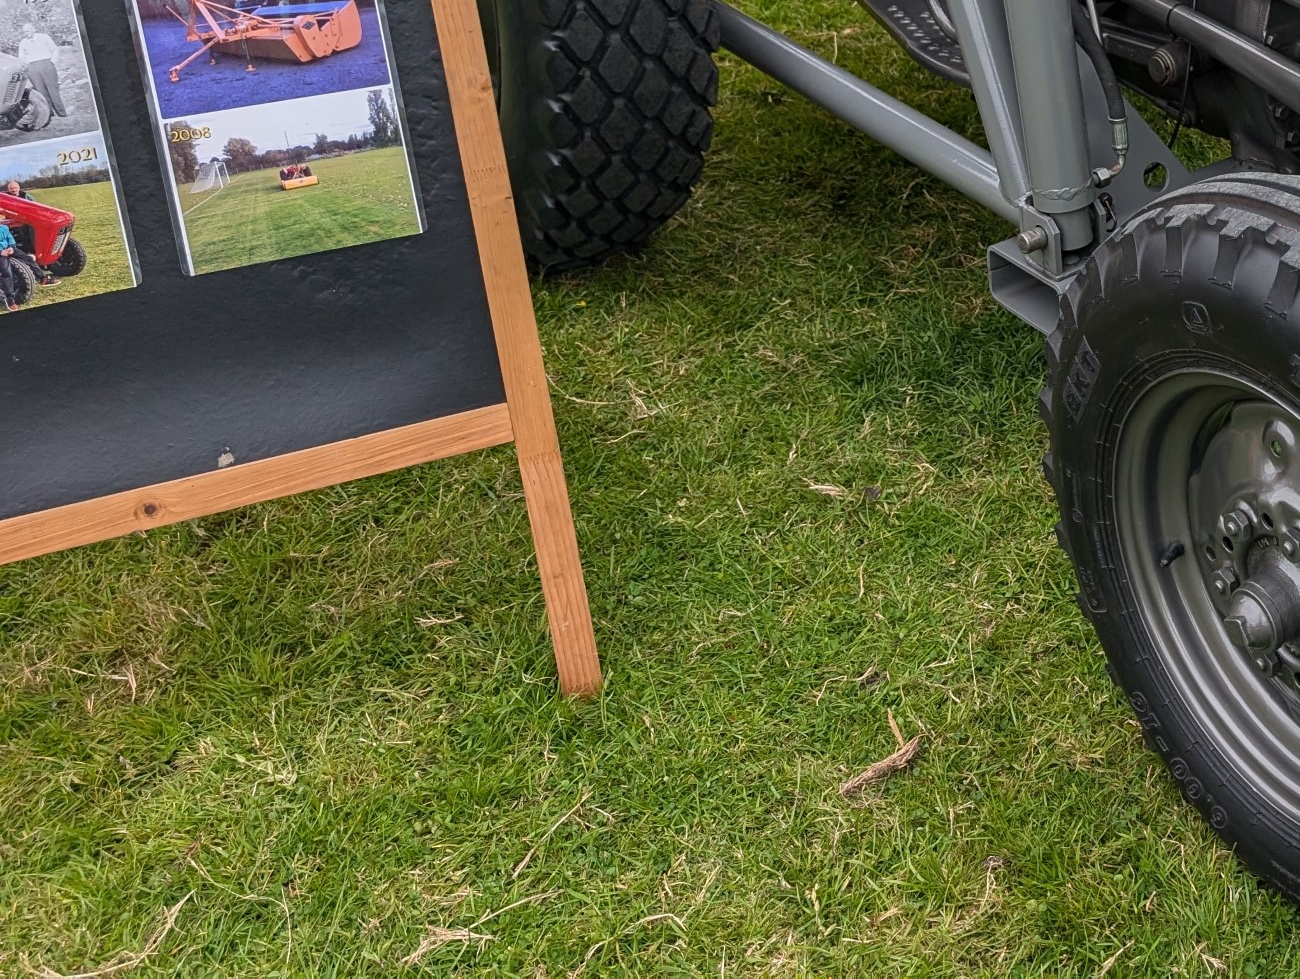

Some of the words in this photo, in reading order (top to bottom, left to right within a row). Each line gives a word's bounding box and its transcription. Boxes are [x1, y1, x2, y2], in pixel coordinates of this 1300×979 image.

[170, 126, 212, 144] 2008
[56, 147, 98, 167] 2021
[1128, 691, 1228, 829] 6.00-16
